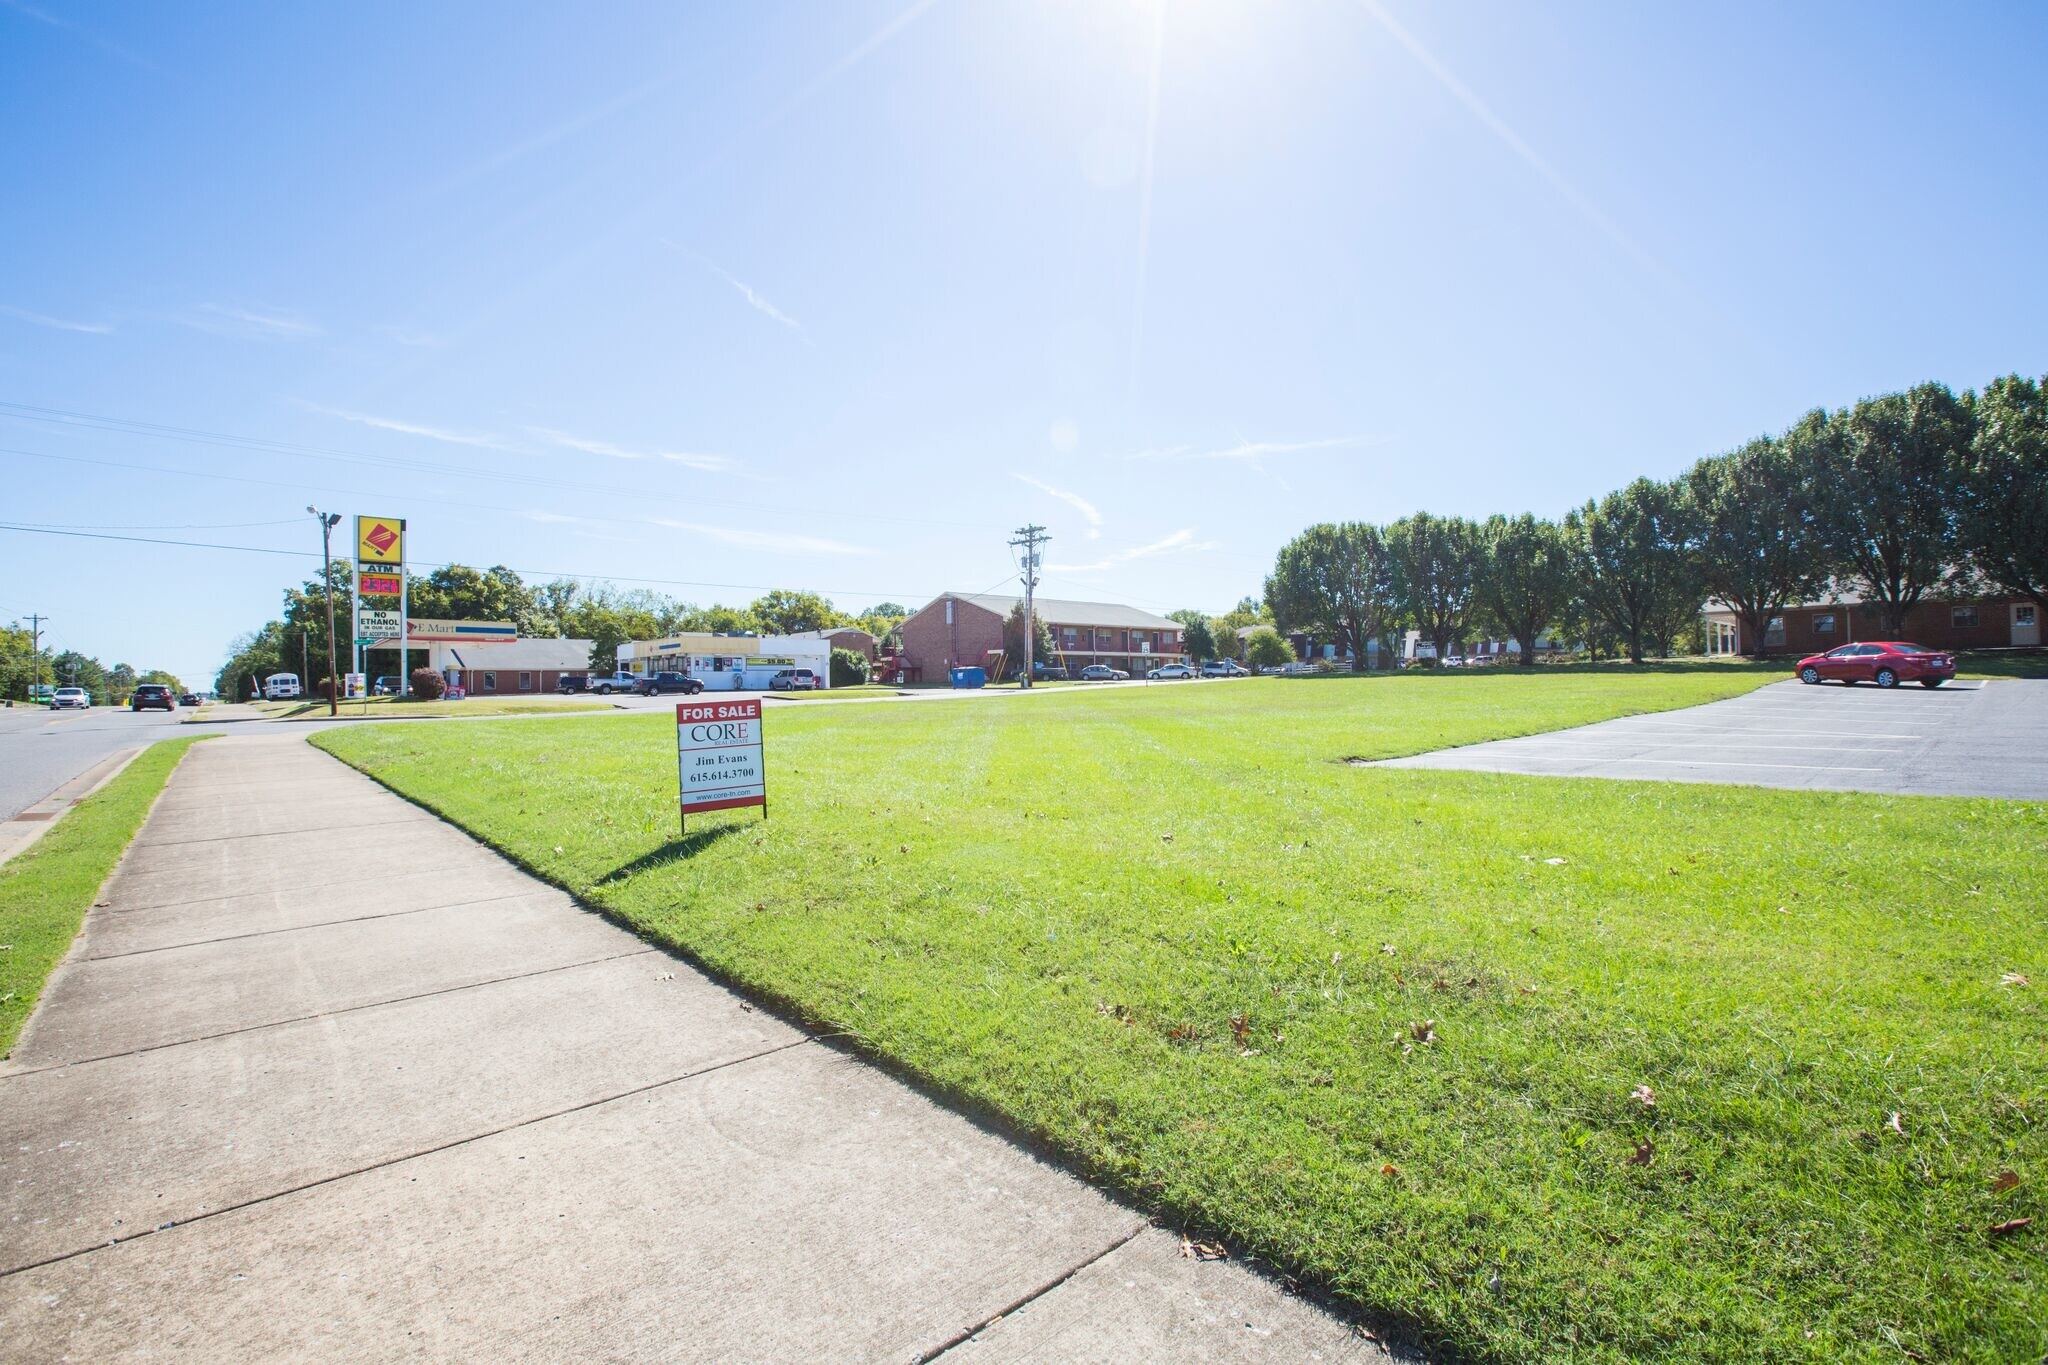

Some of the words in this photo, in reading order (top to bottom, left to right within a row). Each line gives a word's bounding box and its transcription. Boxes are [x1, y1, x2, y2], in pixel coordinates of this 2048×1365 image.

[368, 565, 394, 573] ATM
[374, 611, 387, 619] NO
[360, 618, 399, 626] ETHANOL
[427, 623, 455, 634] Mart
[682, 707, 714, 720] FOR
[718, 705, 756, 718] SALE
[691, 722, 749, 742] CORE
[696, 757, 715, 766] Jim
[718, 754, 748, 765] Evans
[690, 768, 754, 783] 615.614.3700
[696, 789, 751, 801] www.core-tn.com
